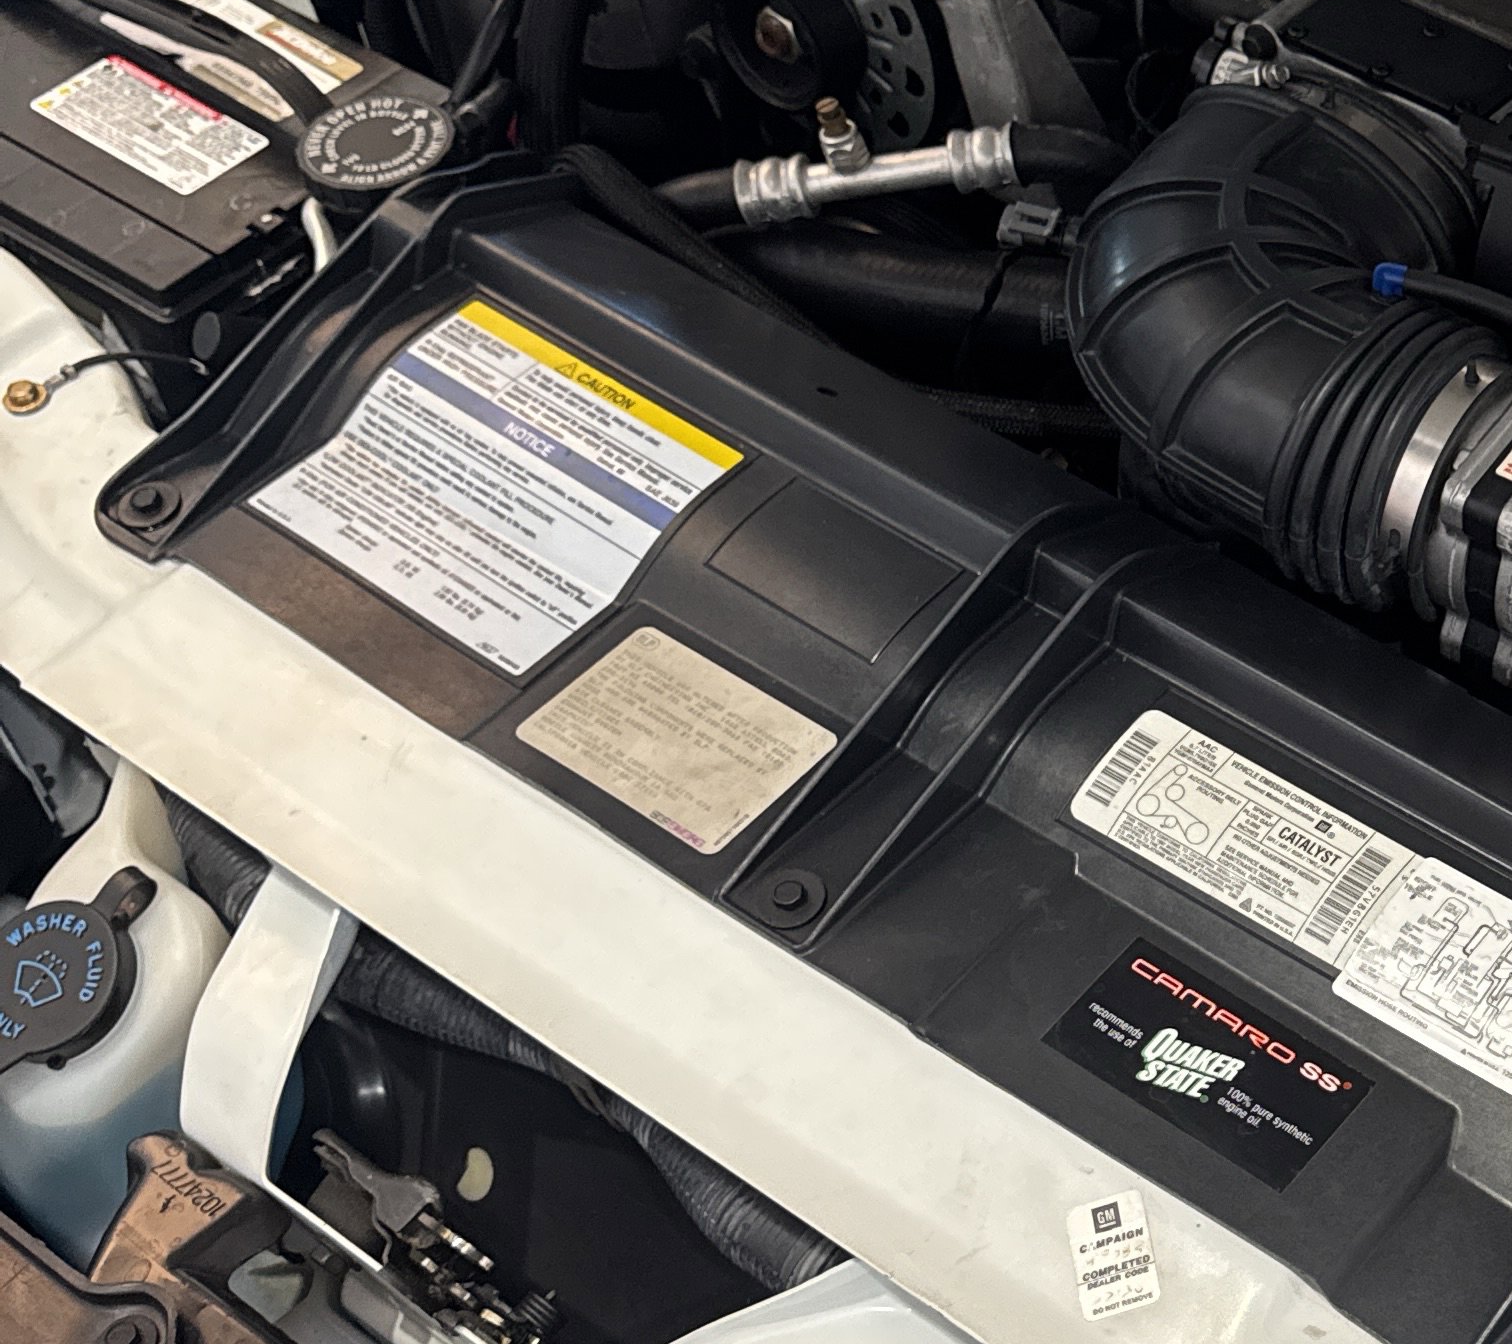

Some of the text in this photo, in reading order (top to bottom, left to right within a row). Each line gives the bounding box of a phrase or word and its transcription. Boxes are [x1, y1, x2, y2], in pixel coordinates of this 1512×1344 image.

[370, 97, 404, 108] HOT
[575, 373, 635, 410] CAUTION
[502, 422, 554, 456] NOTICE
[1198, 739, 1219, 753] AAC
[1289, 793, 1322, 814] CONTROL
[1321, 810, 1367, 839] INFORMATION
[1277, 826, 1341, 867] CATALYST
[7, 914, 102, 1000] WASHER FLUID
[1087, 1002, 1143, 1040] recommends
[1092, 1019, 1136, 1048] the use of
[1128, 957, 1342, 1093] CAMARO SS
[1141, 1027, 1247, 1083] QUAKER
[1135, 1053, 1211, 1100] STATE
[1215, 1096, 1263, 1127] engine oil.
[1225, 1087, 1314, 1146] 100% pure synthetic
[151, 1152, 225, 1220] 10247777
[1082, 1255, 1149, 1281] COMPLETED
[1087, 1274, 1120, 1289] DEALER
